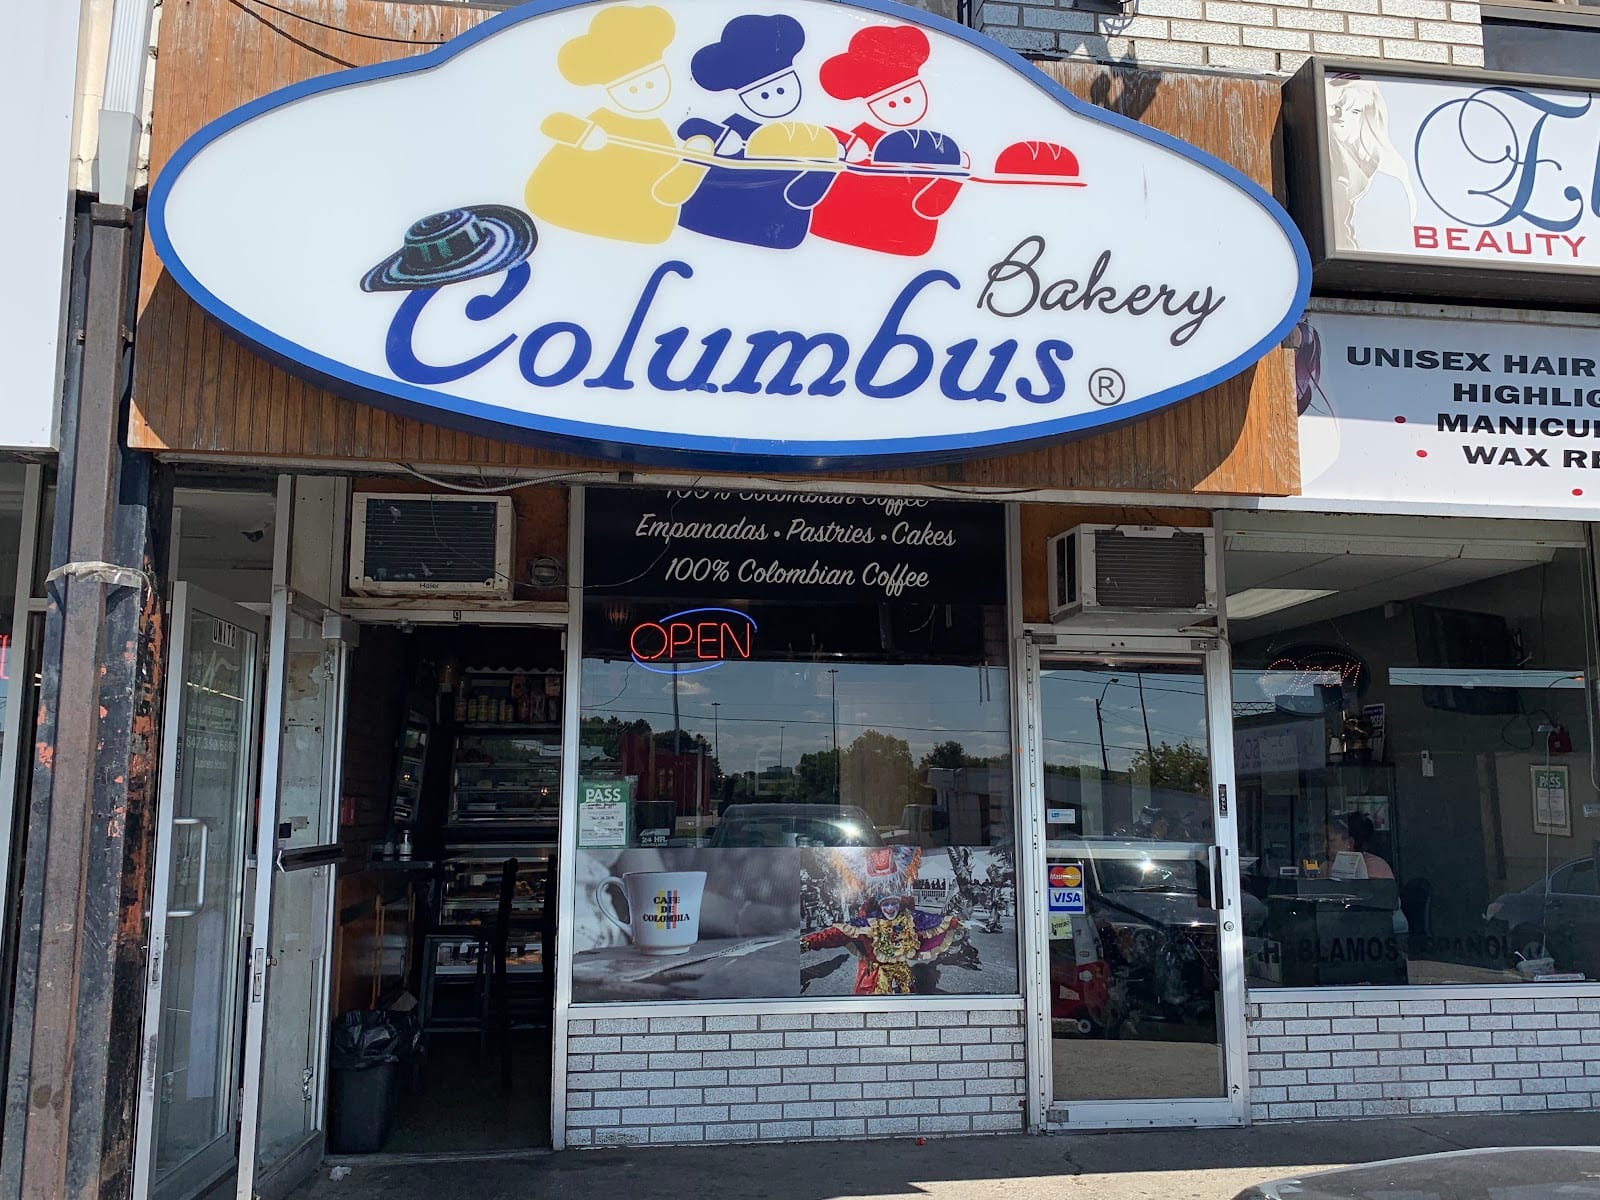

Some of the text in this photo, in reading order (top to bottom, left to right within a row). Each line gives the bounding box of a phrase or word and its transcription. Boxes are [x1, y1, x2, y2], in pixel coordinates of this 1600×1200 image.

[1413, 226, 1586, 257] BEAUTY
[977, 235, 1225, 346] Bakery
[385, 260, 1074, 404] Columbus
[1347, 346, 1596, 377] UNISEX HAIR
[1462, 446, 1550, 467] WAX
[635, 514, 957, 547] Empanadas Pastries Cakes
[665, 557, 930, 597] 100% Colombian Coffee
[630, 622, 750, 660] OPEN
[585, 787, 621, 802] PASS
[1054, 892, 1081, 903] VISA
[1263, 937, 1399, 964] HBLAMOS
